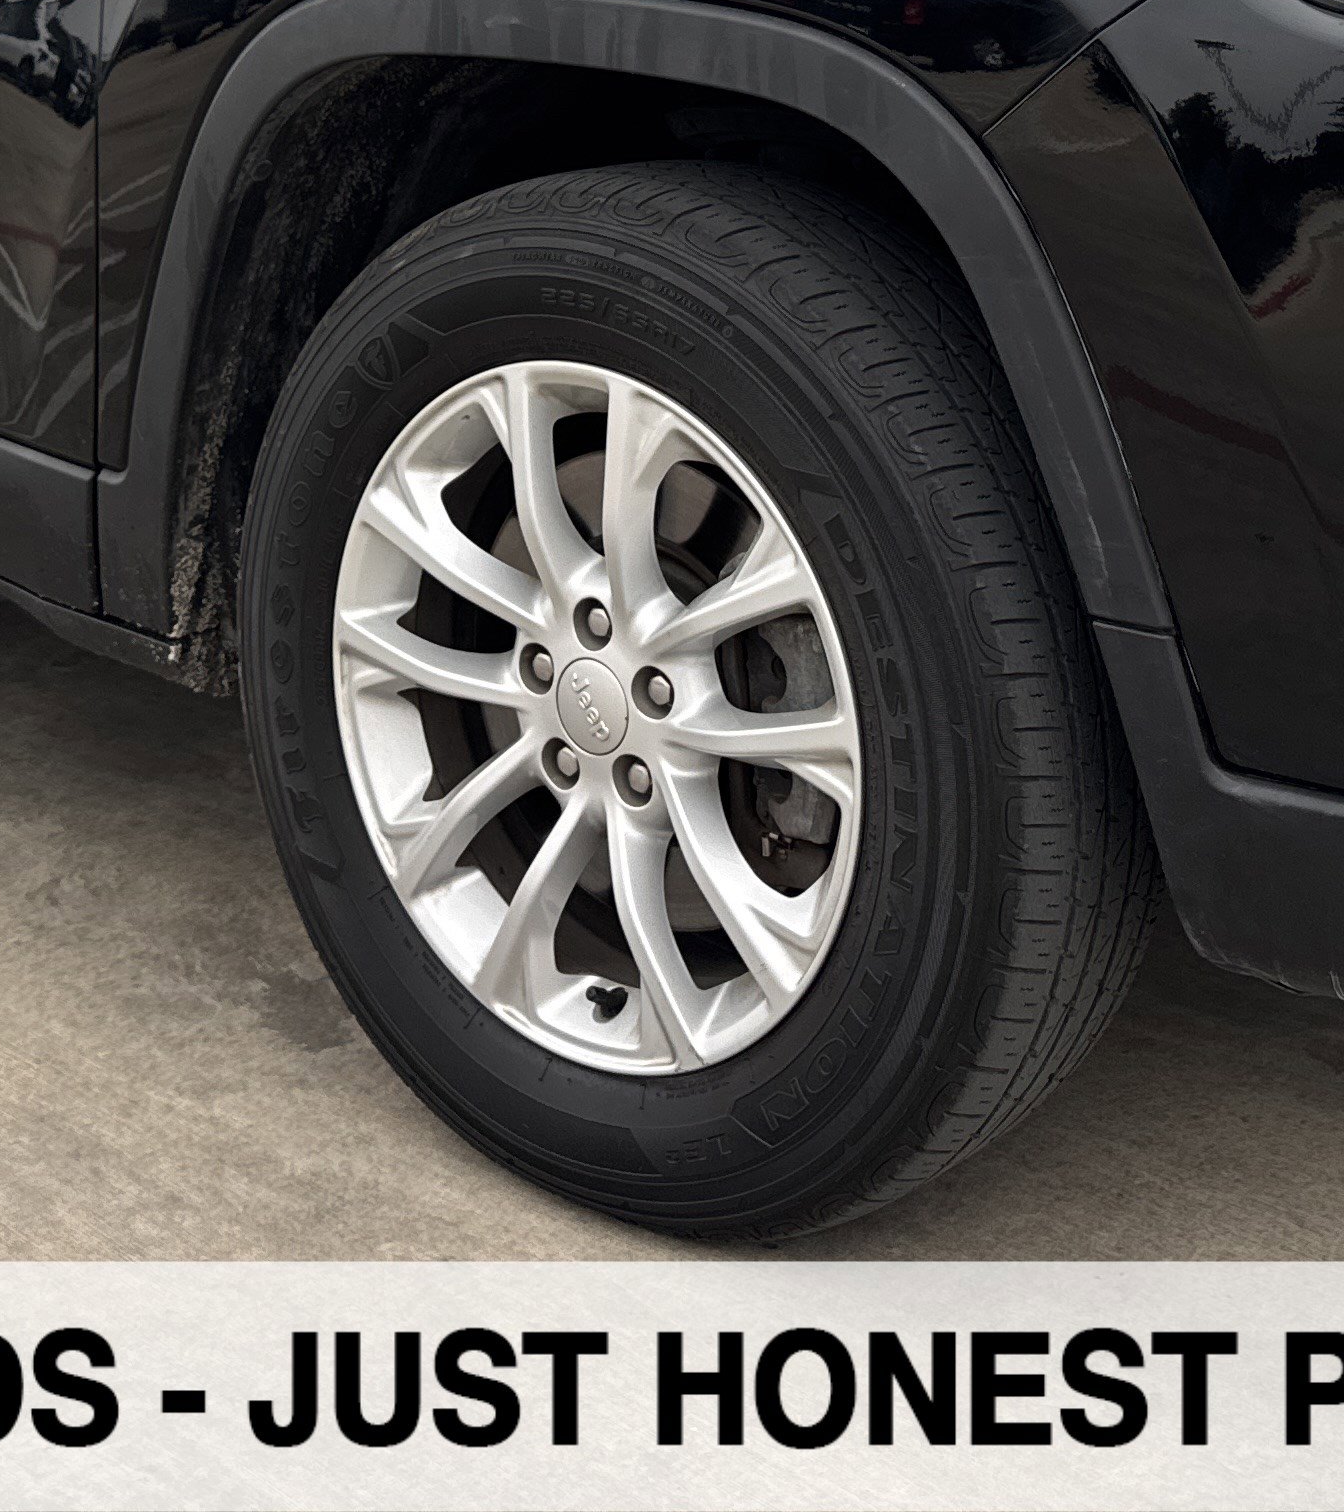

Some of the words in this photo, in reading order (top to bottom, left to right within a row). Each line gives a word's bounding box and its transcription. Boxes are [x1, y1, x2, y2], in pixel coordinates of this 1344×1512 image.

[268, 388, 354, 833] Firestone
[570, 672, 611, 741] Jeep
[759, 516, 922, 1133] DESTINATION
